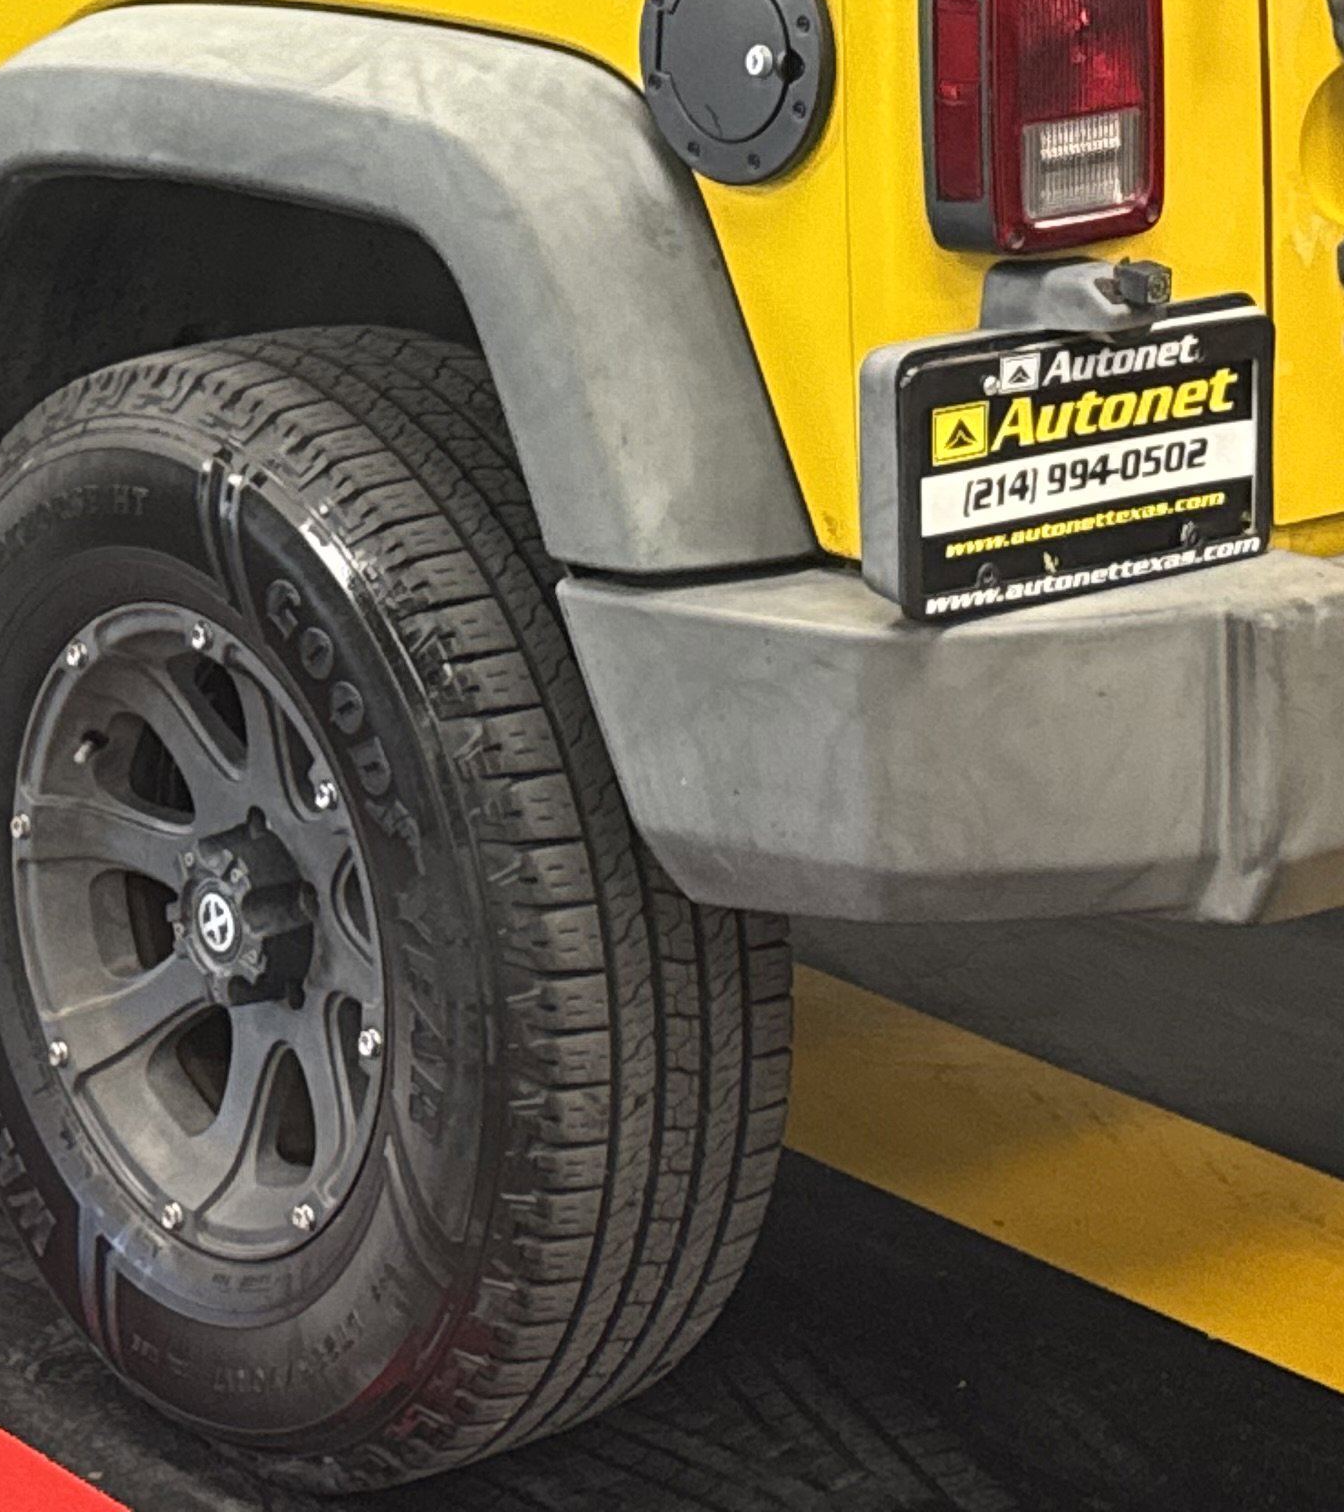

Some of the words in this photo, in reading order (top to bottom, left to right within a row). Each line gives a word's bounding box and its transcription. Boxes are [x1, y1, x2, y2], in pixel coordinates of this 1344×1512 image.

[1042, 334, 1201, 387] Autonet
[990, 368, 1239, 452] Autonet
[963, 467, 1038, 518] (214)
[1047, 437, 1209, 496] 994-0502
[945, 491, 1225, 559] www.autonettexas.com
[926, 536, 1261, 616] www.autonettexas.com
